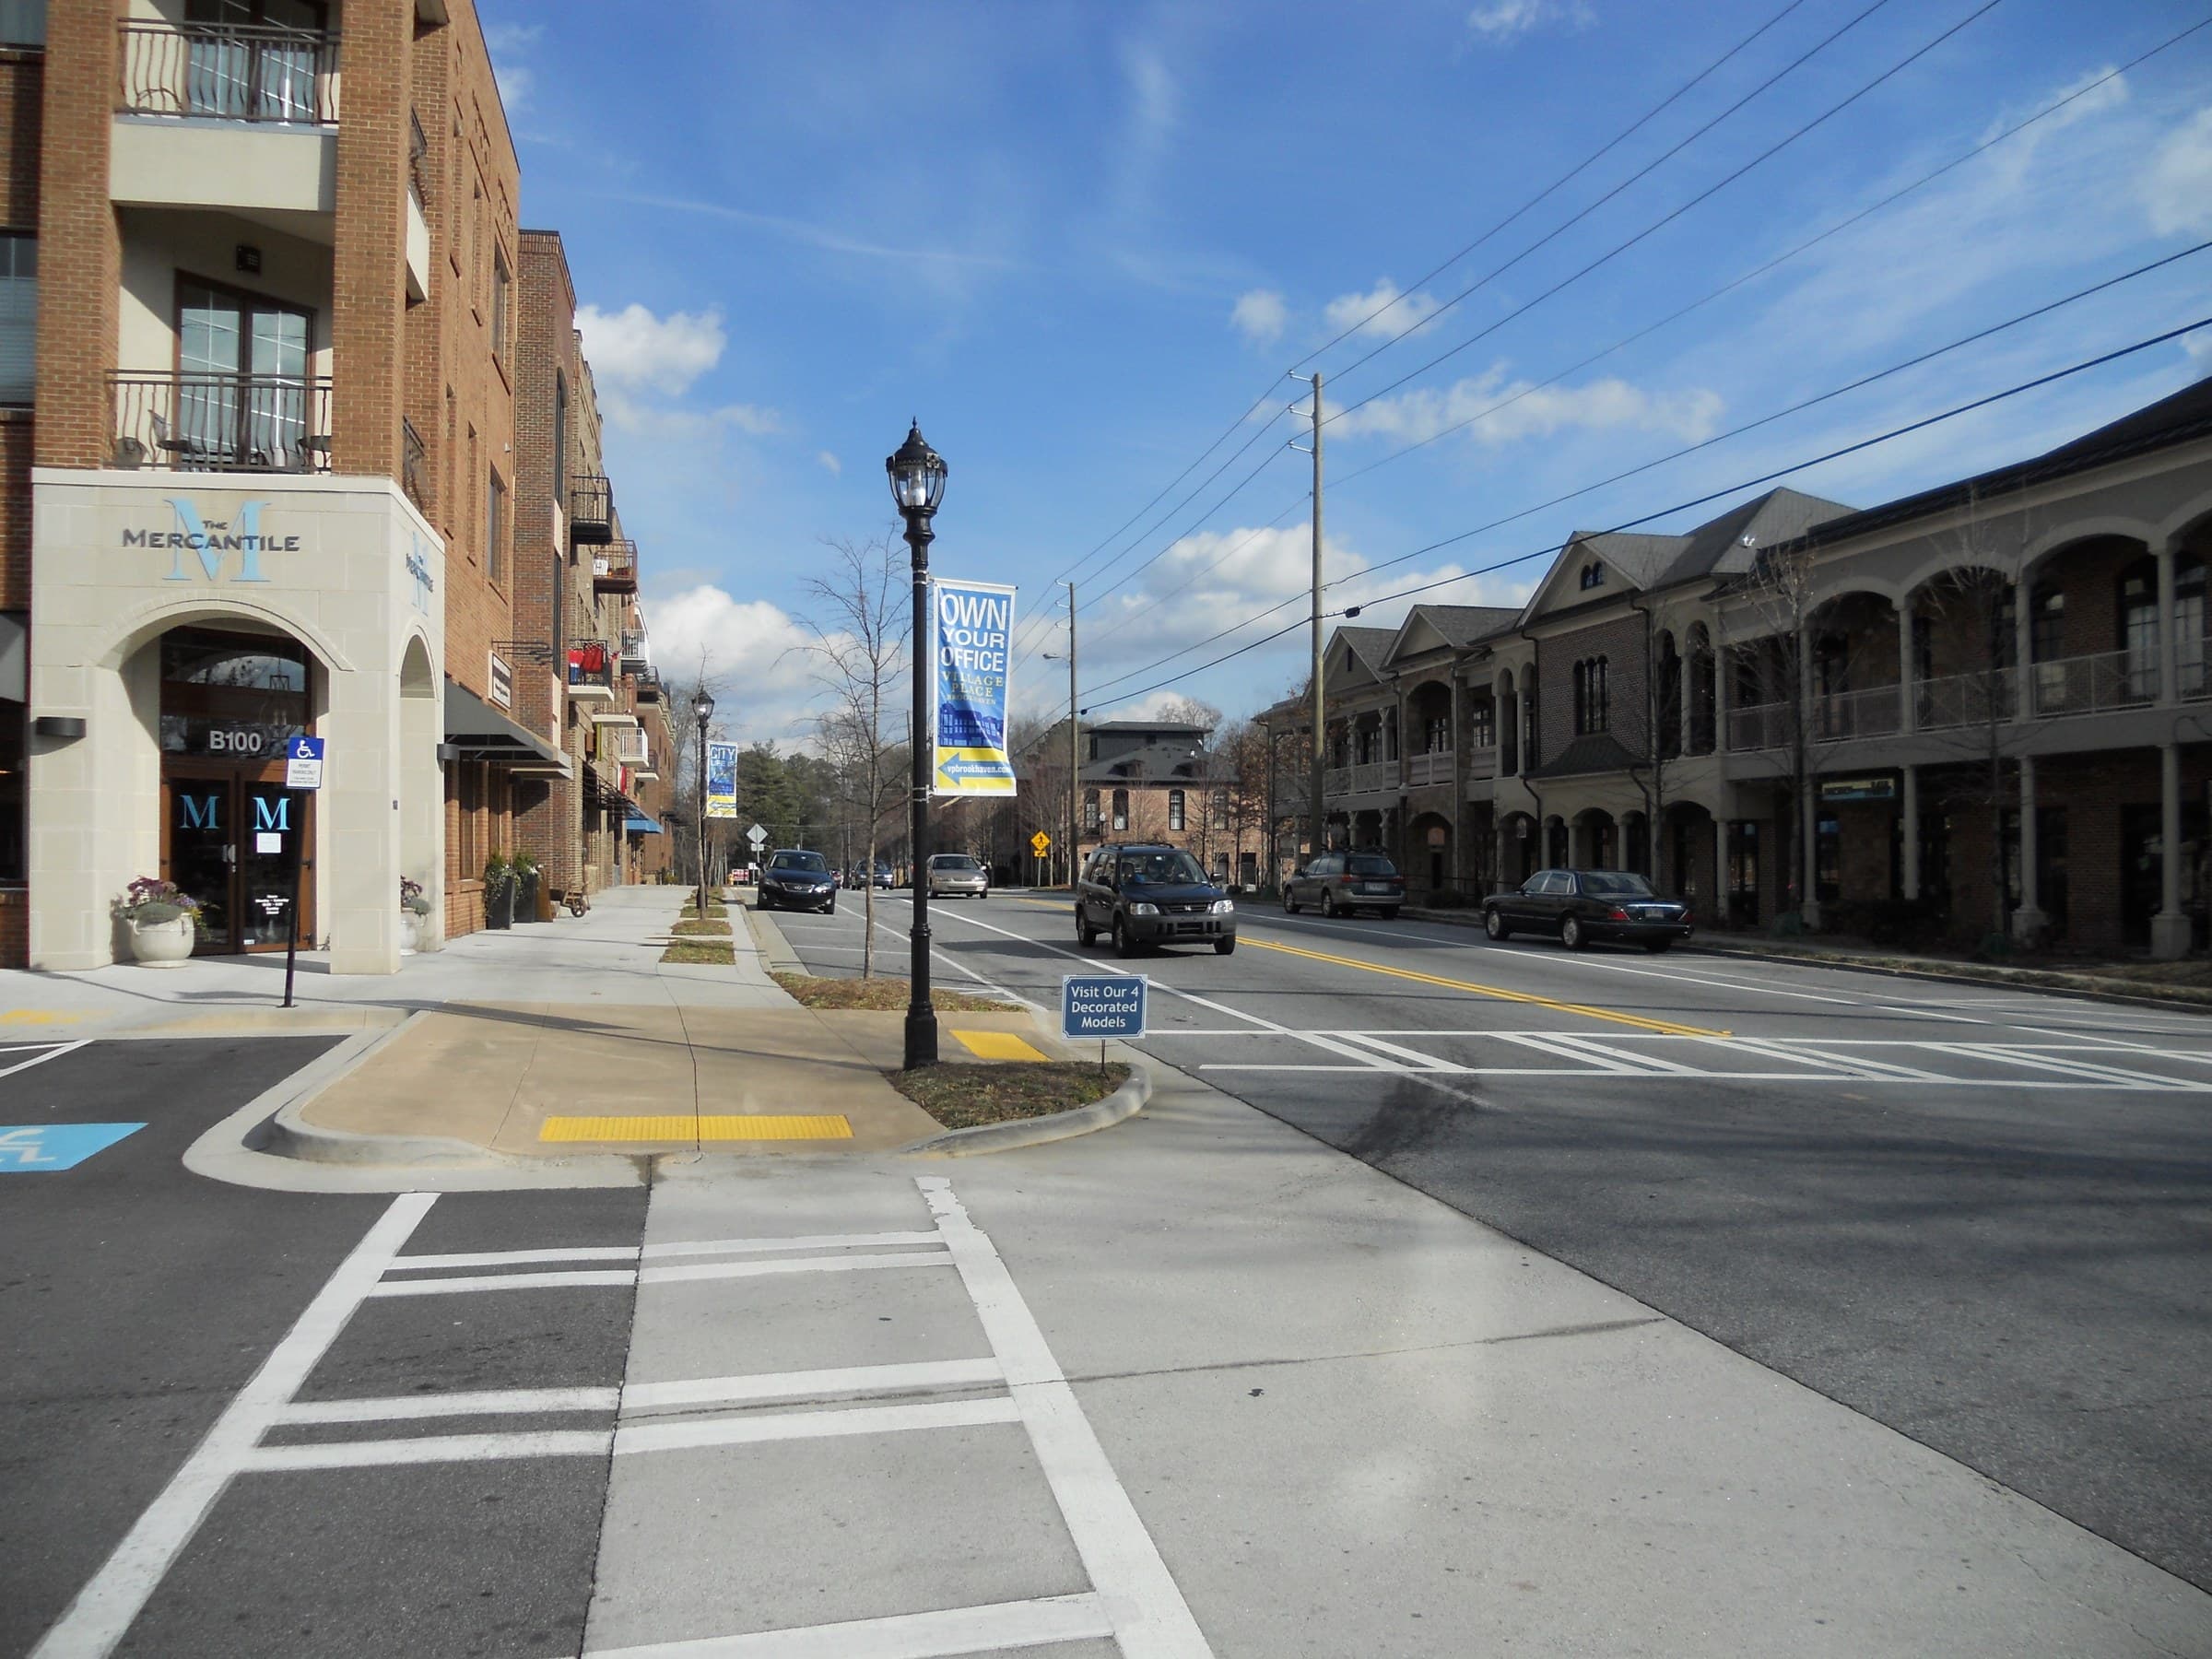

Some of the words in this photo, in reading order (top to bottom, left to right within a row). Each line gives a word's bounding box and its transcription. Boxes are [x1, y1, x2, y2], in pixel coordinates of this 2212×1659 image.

[203, 520, 228, 530] THE
[123, 528, 300, 552] MERCANTILE
[940, 594, 1006, 630] OWN
[942, 627, 1005, 649] YOUR
[941, 646, 1004, 673] OFFICE
[942, 671, 1004, 687] VILLAGE
[952, 683, 994, 698] PLACE
[209, 730, 262, 751] B100
[711, 747, 735, 760] CITY
[947, 764, 1011, 774] vpbrookhaven.com
[180, 794, 220, 829] M
[253, 796, 291, 830] M
[1071, 985, 1100, 997] Visit
[1103, 985, 1127, 997] Our
[1130, 985, 1139, 997] 4
[1071, 1000, 1137, 1013] Decorated
[1081, 1016, 1126, 1029] Models
